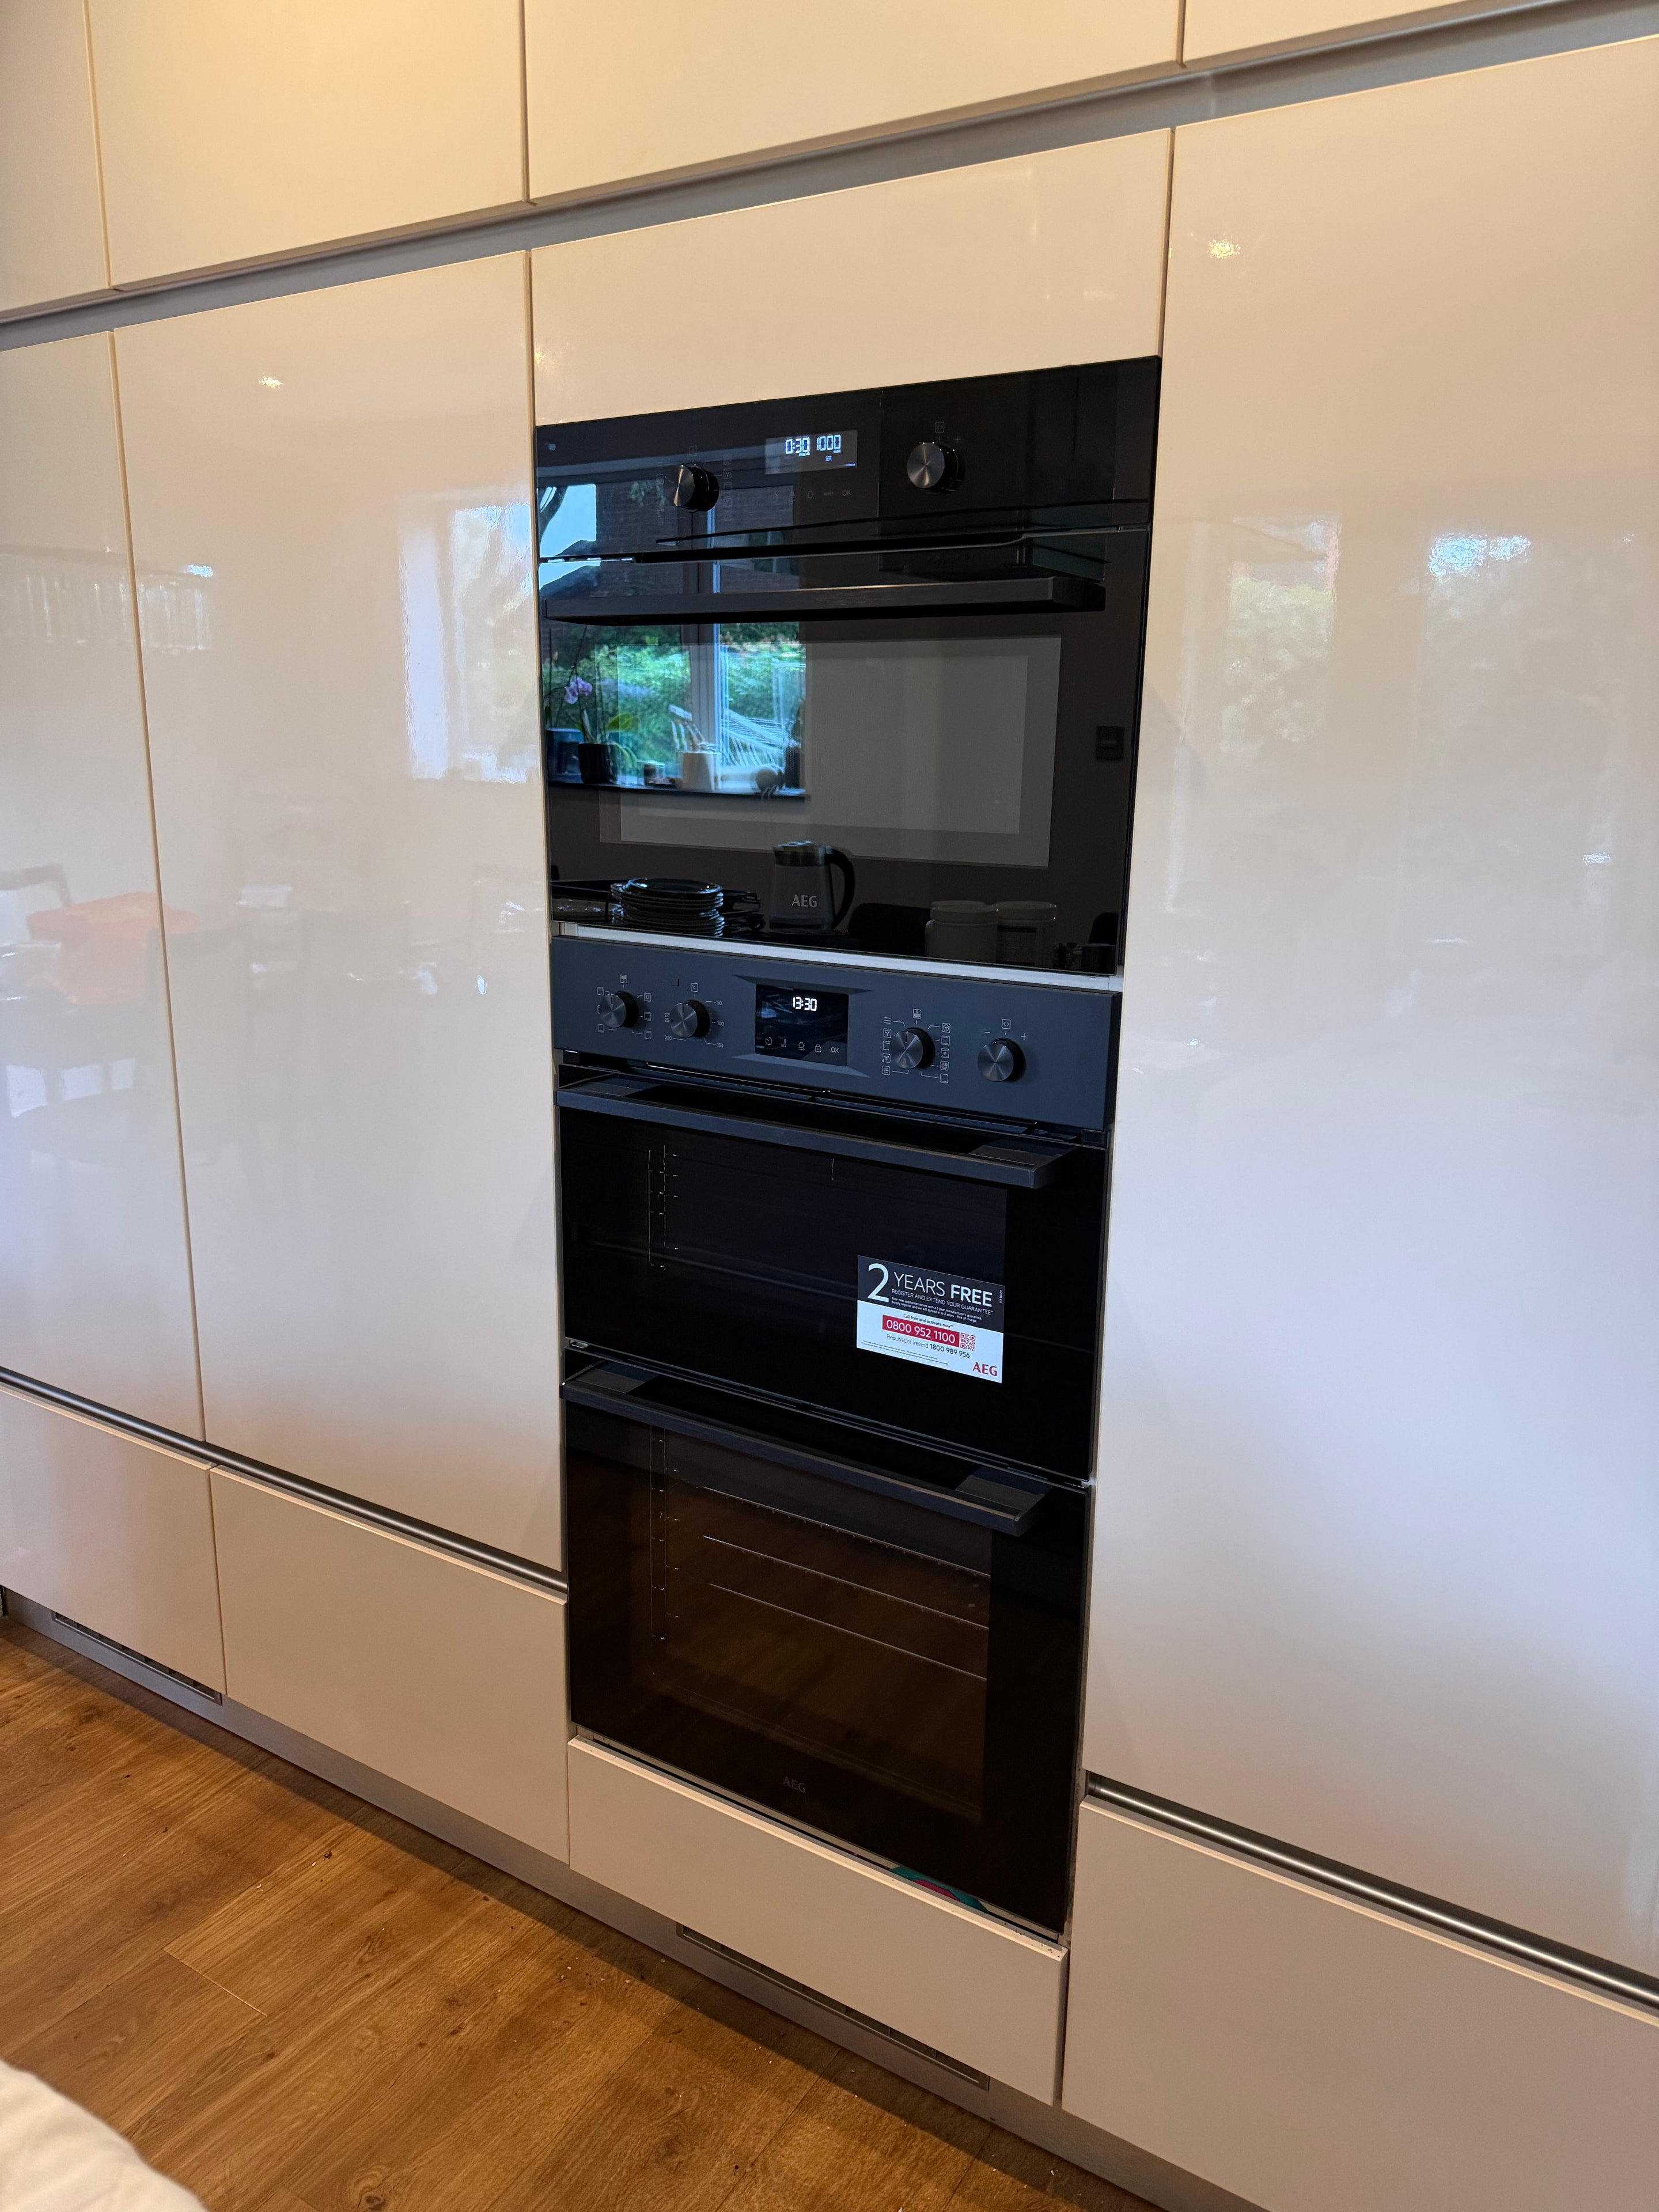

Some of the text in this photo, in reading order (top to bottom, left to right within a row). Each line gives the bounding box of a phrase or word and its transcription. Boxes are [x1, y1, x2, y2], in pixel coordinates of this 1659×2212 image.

[817, 435, 841, 451] 1000
[791, 894, 817, 908] AEG
[793, 997, 817, 1012] 13:30
[868, 1263, 889, 1302] 2
[893, 1271, 945, 1296] YEARS
[950, 1284, 992, 1306] FREE
[891, 1288, 914, 1297] REGISTER
[926, 1296, 945, 1305] EXTEND
[886, 1319, 955, 1343] 0800 952 1100
[887, 1334, 906, 1343] Republic
[929, 1343, 944, 1351] 1800
[972, 1362, 997, 1376] AEG
[783, 1776, 805, 1793] AEG
